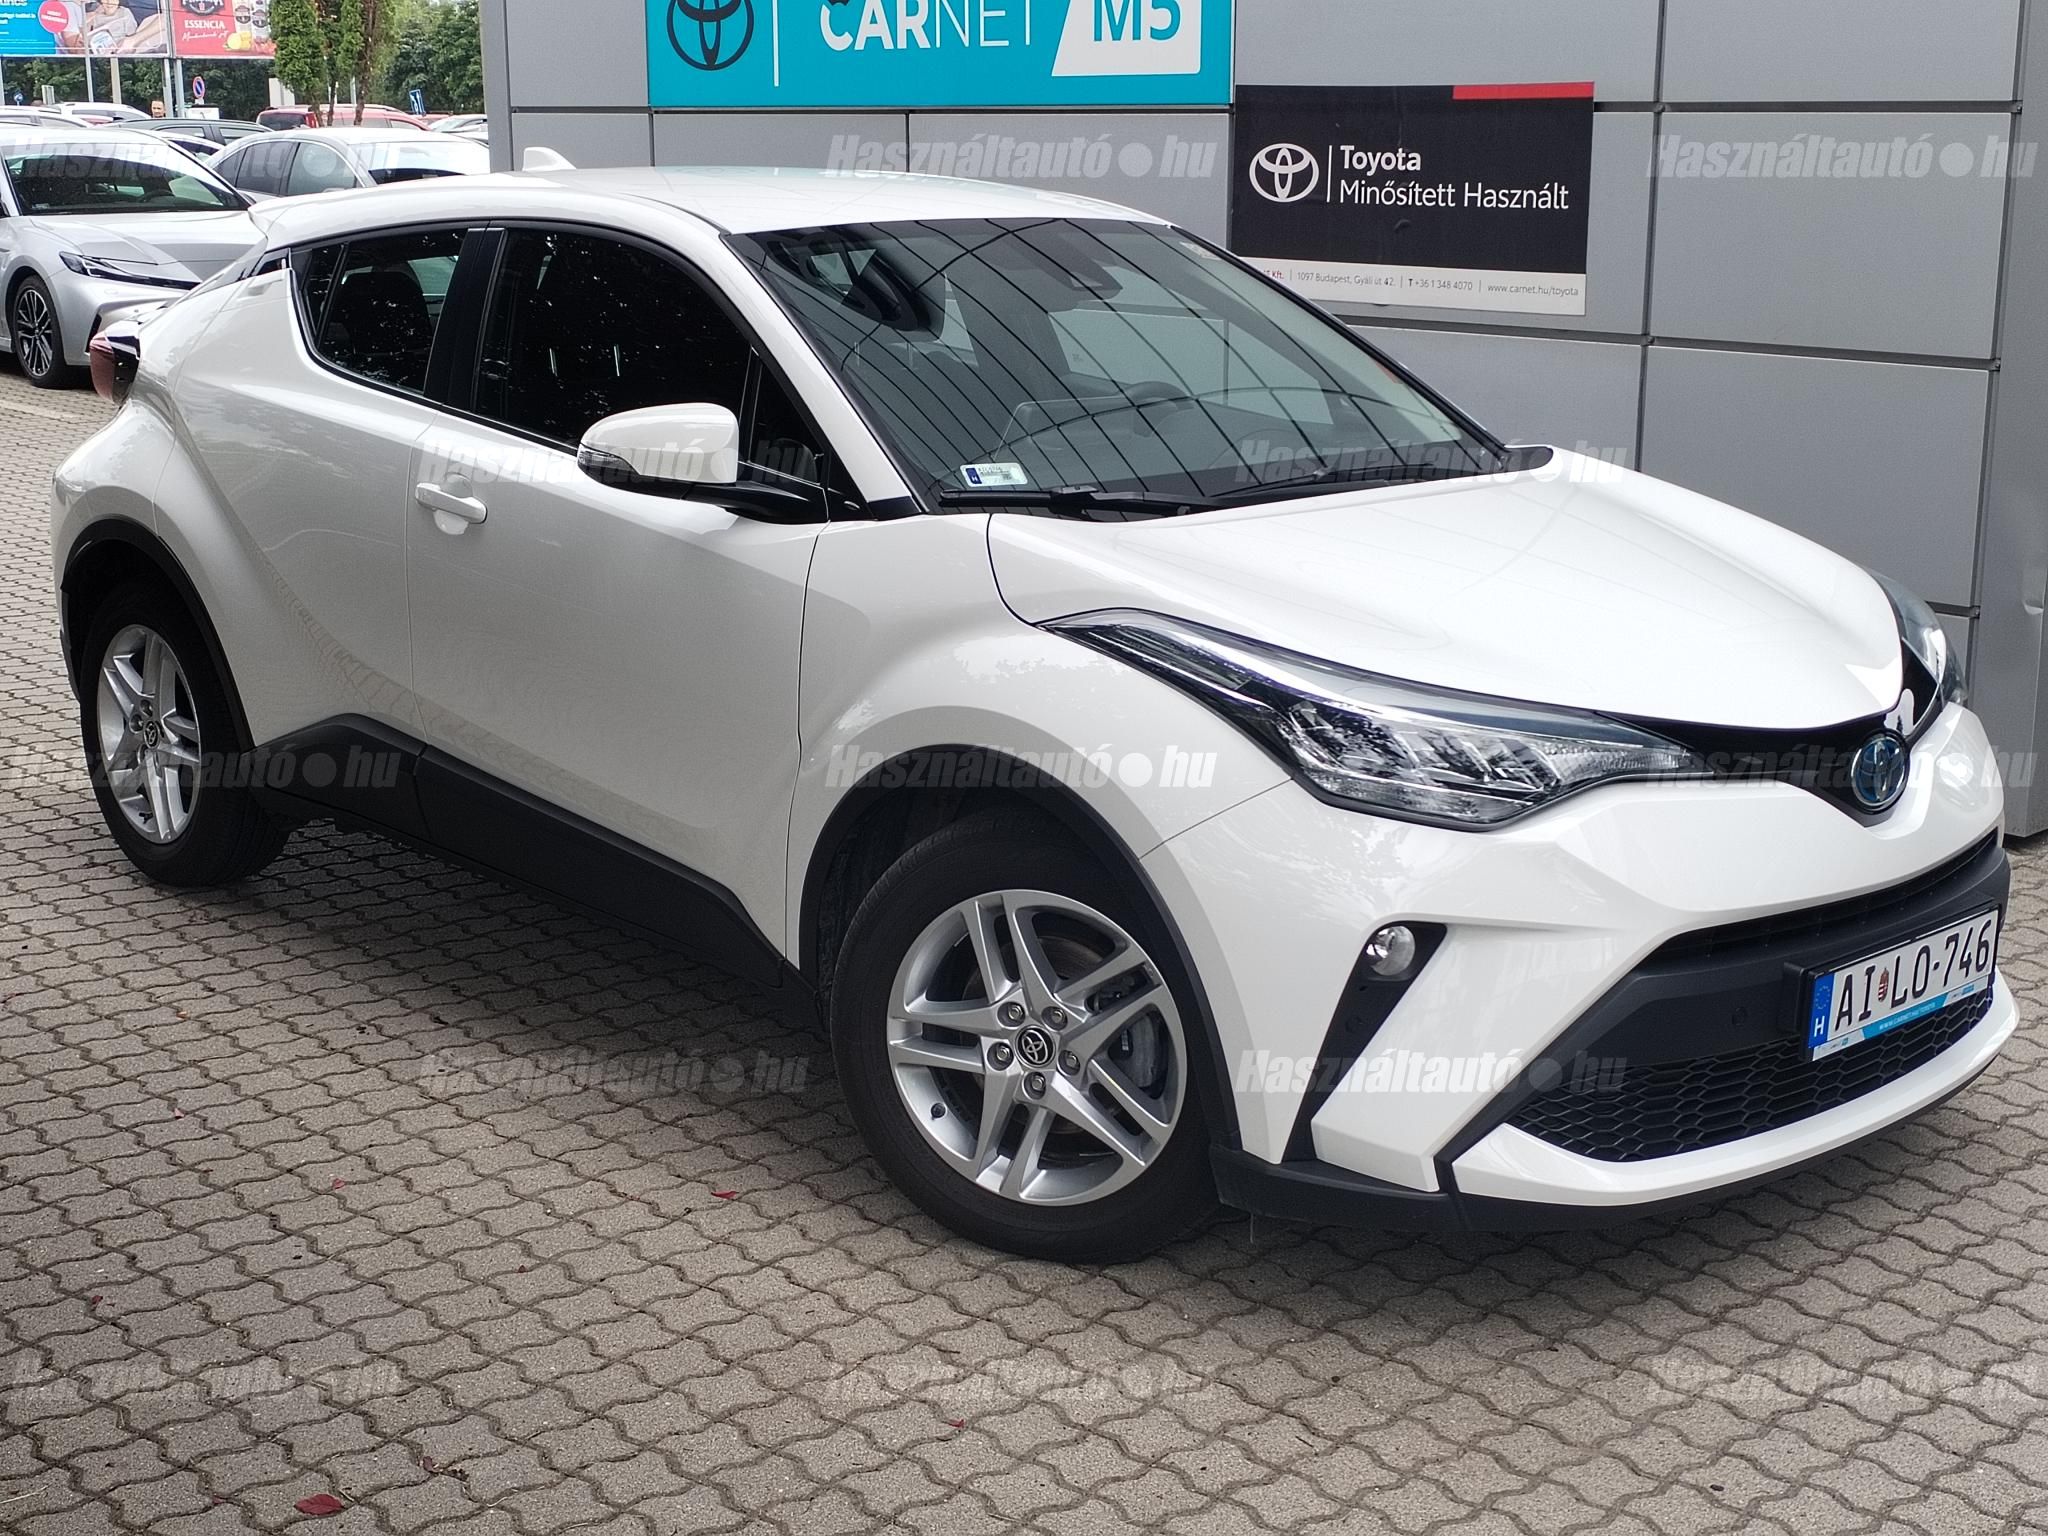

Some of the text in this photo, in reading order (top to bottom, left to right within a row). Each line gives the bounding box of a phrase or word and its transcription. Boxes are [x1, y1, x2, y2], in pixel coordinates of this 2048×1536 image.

[184, 19, 225, 29] ESSENCIA
[1340, 144, 1422, 176] Toyota
[1340, 179, 1569, 209] Minősített Használt
[1297, 272, 1314, 281] 1097
[1408, 278, 1413, 287] T
[1453, 281, 1473, 291] 4070
[1814, 1016, 1825, 1038] H
